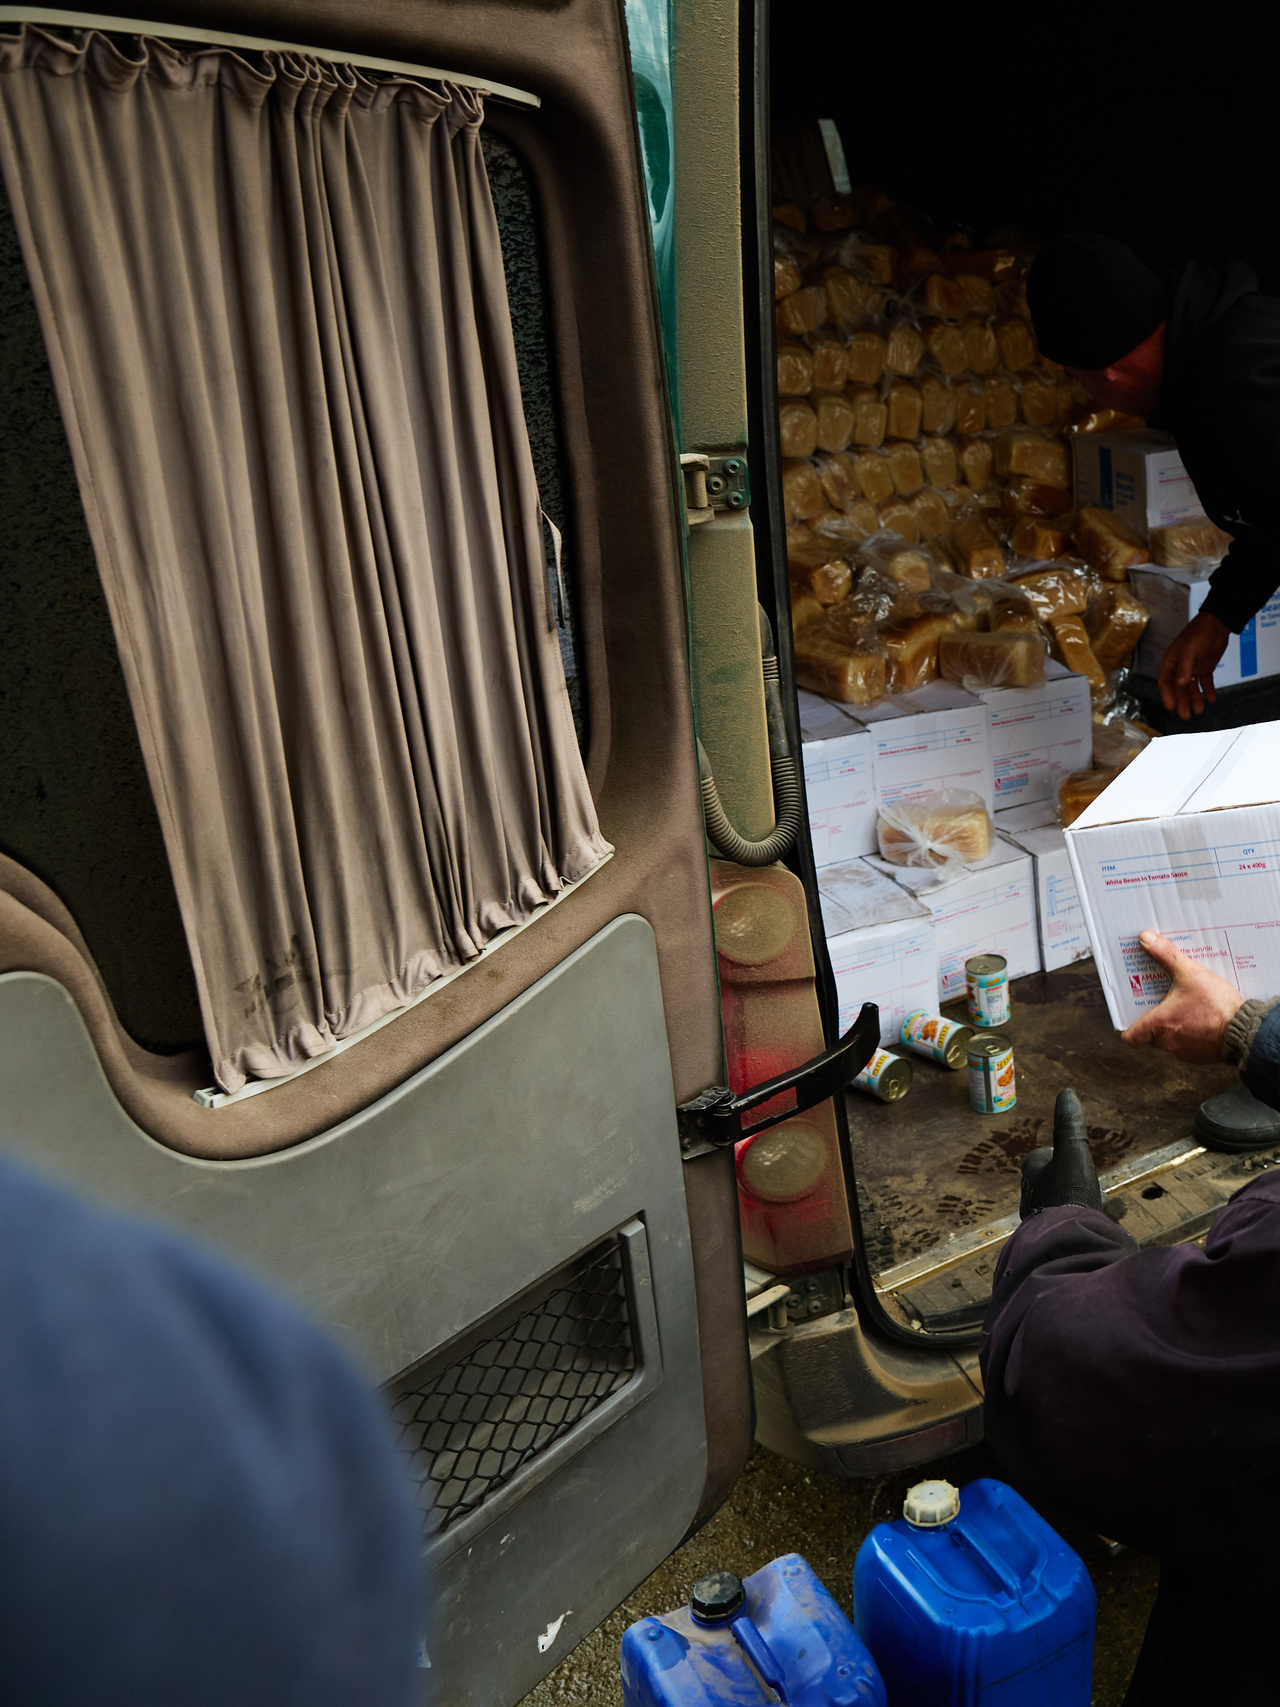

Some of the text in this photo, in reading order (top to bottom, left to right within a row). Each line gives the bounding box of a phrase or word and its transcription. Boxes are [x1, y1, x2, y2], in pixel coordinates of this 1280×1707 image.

[1242, 847, 1255, 855] QTY
[1101, 864, 1116, 872] ITEM
[1147, 873, 1171, 882] Tomato
[1170, 871, 1189, 879] Sauce
[1120, 939, 1141, 948] Purcha
